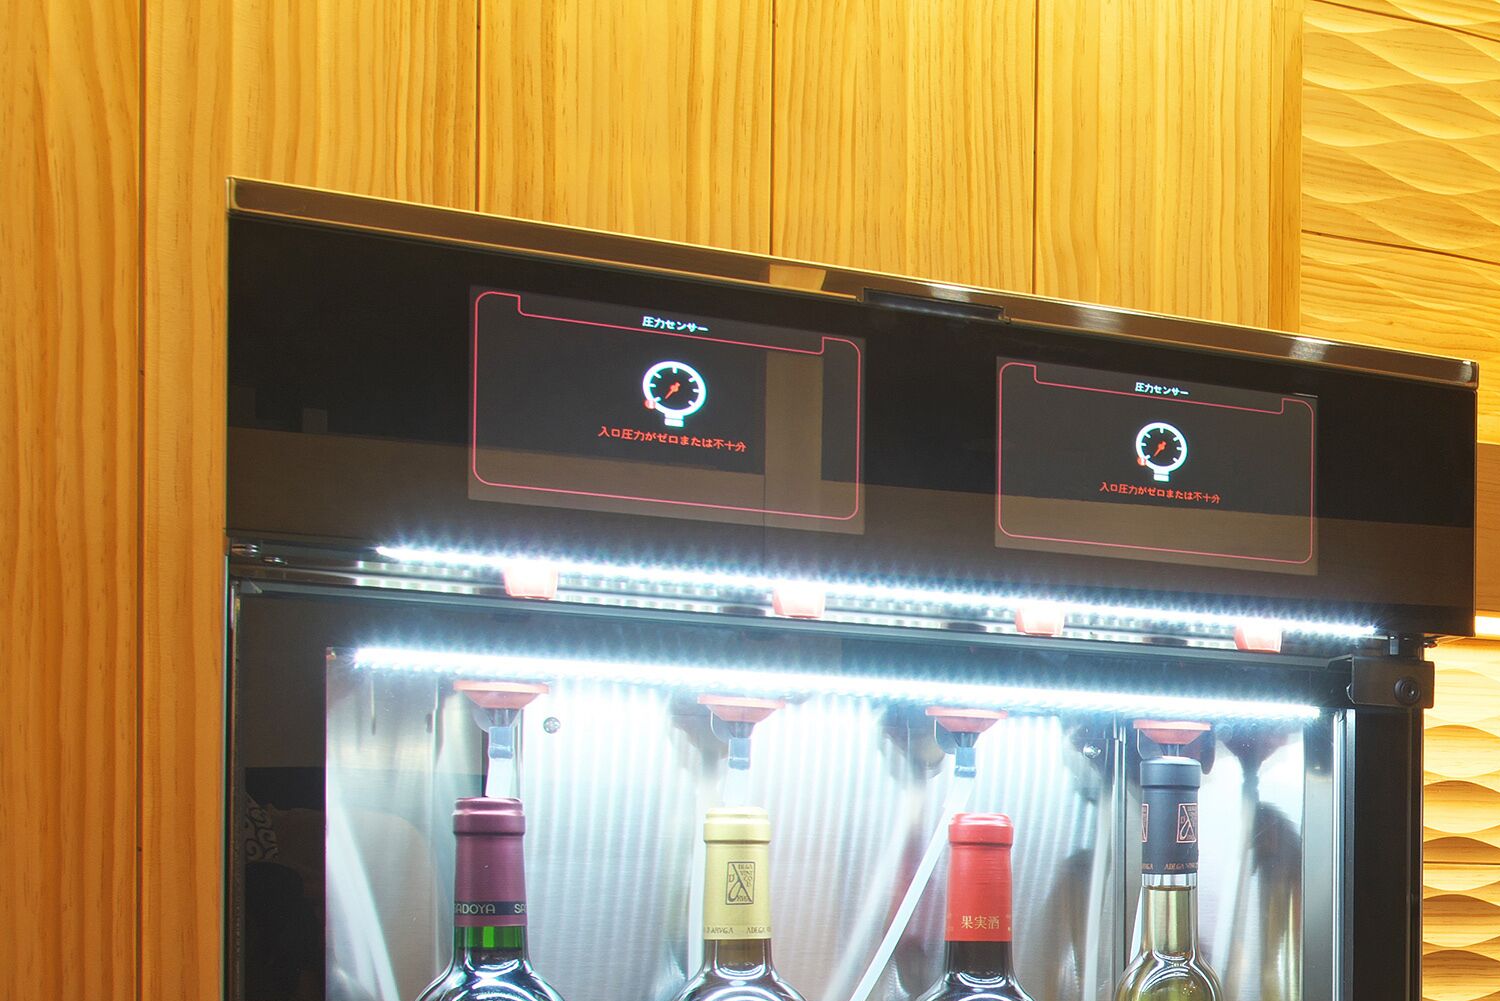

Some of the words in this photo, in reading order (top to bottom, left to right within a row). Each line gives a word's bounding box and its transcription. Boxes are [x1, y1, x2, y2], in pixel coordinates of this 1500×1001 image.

[642, 315, 709, 332] 圧力センサー
[1134, 381, 1189, 397] 圧力センサー
[455, 903, 496, 914] ADOYA
[961, 915, 1000, 929] 果実酒
